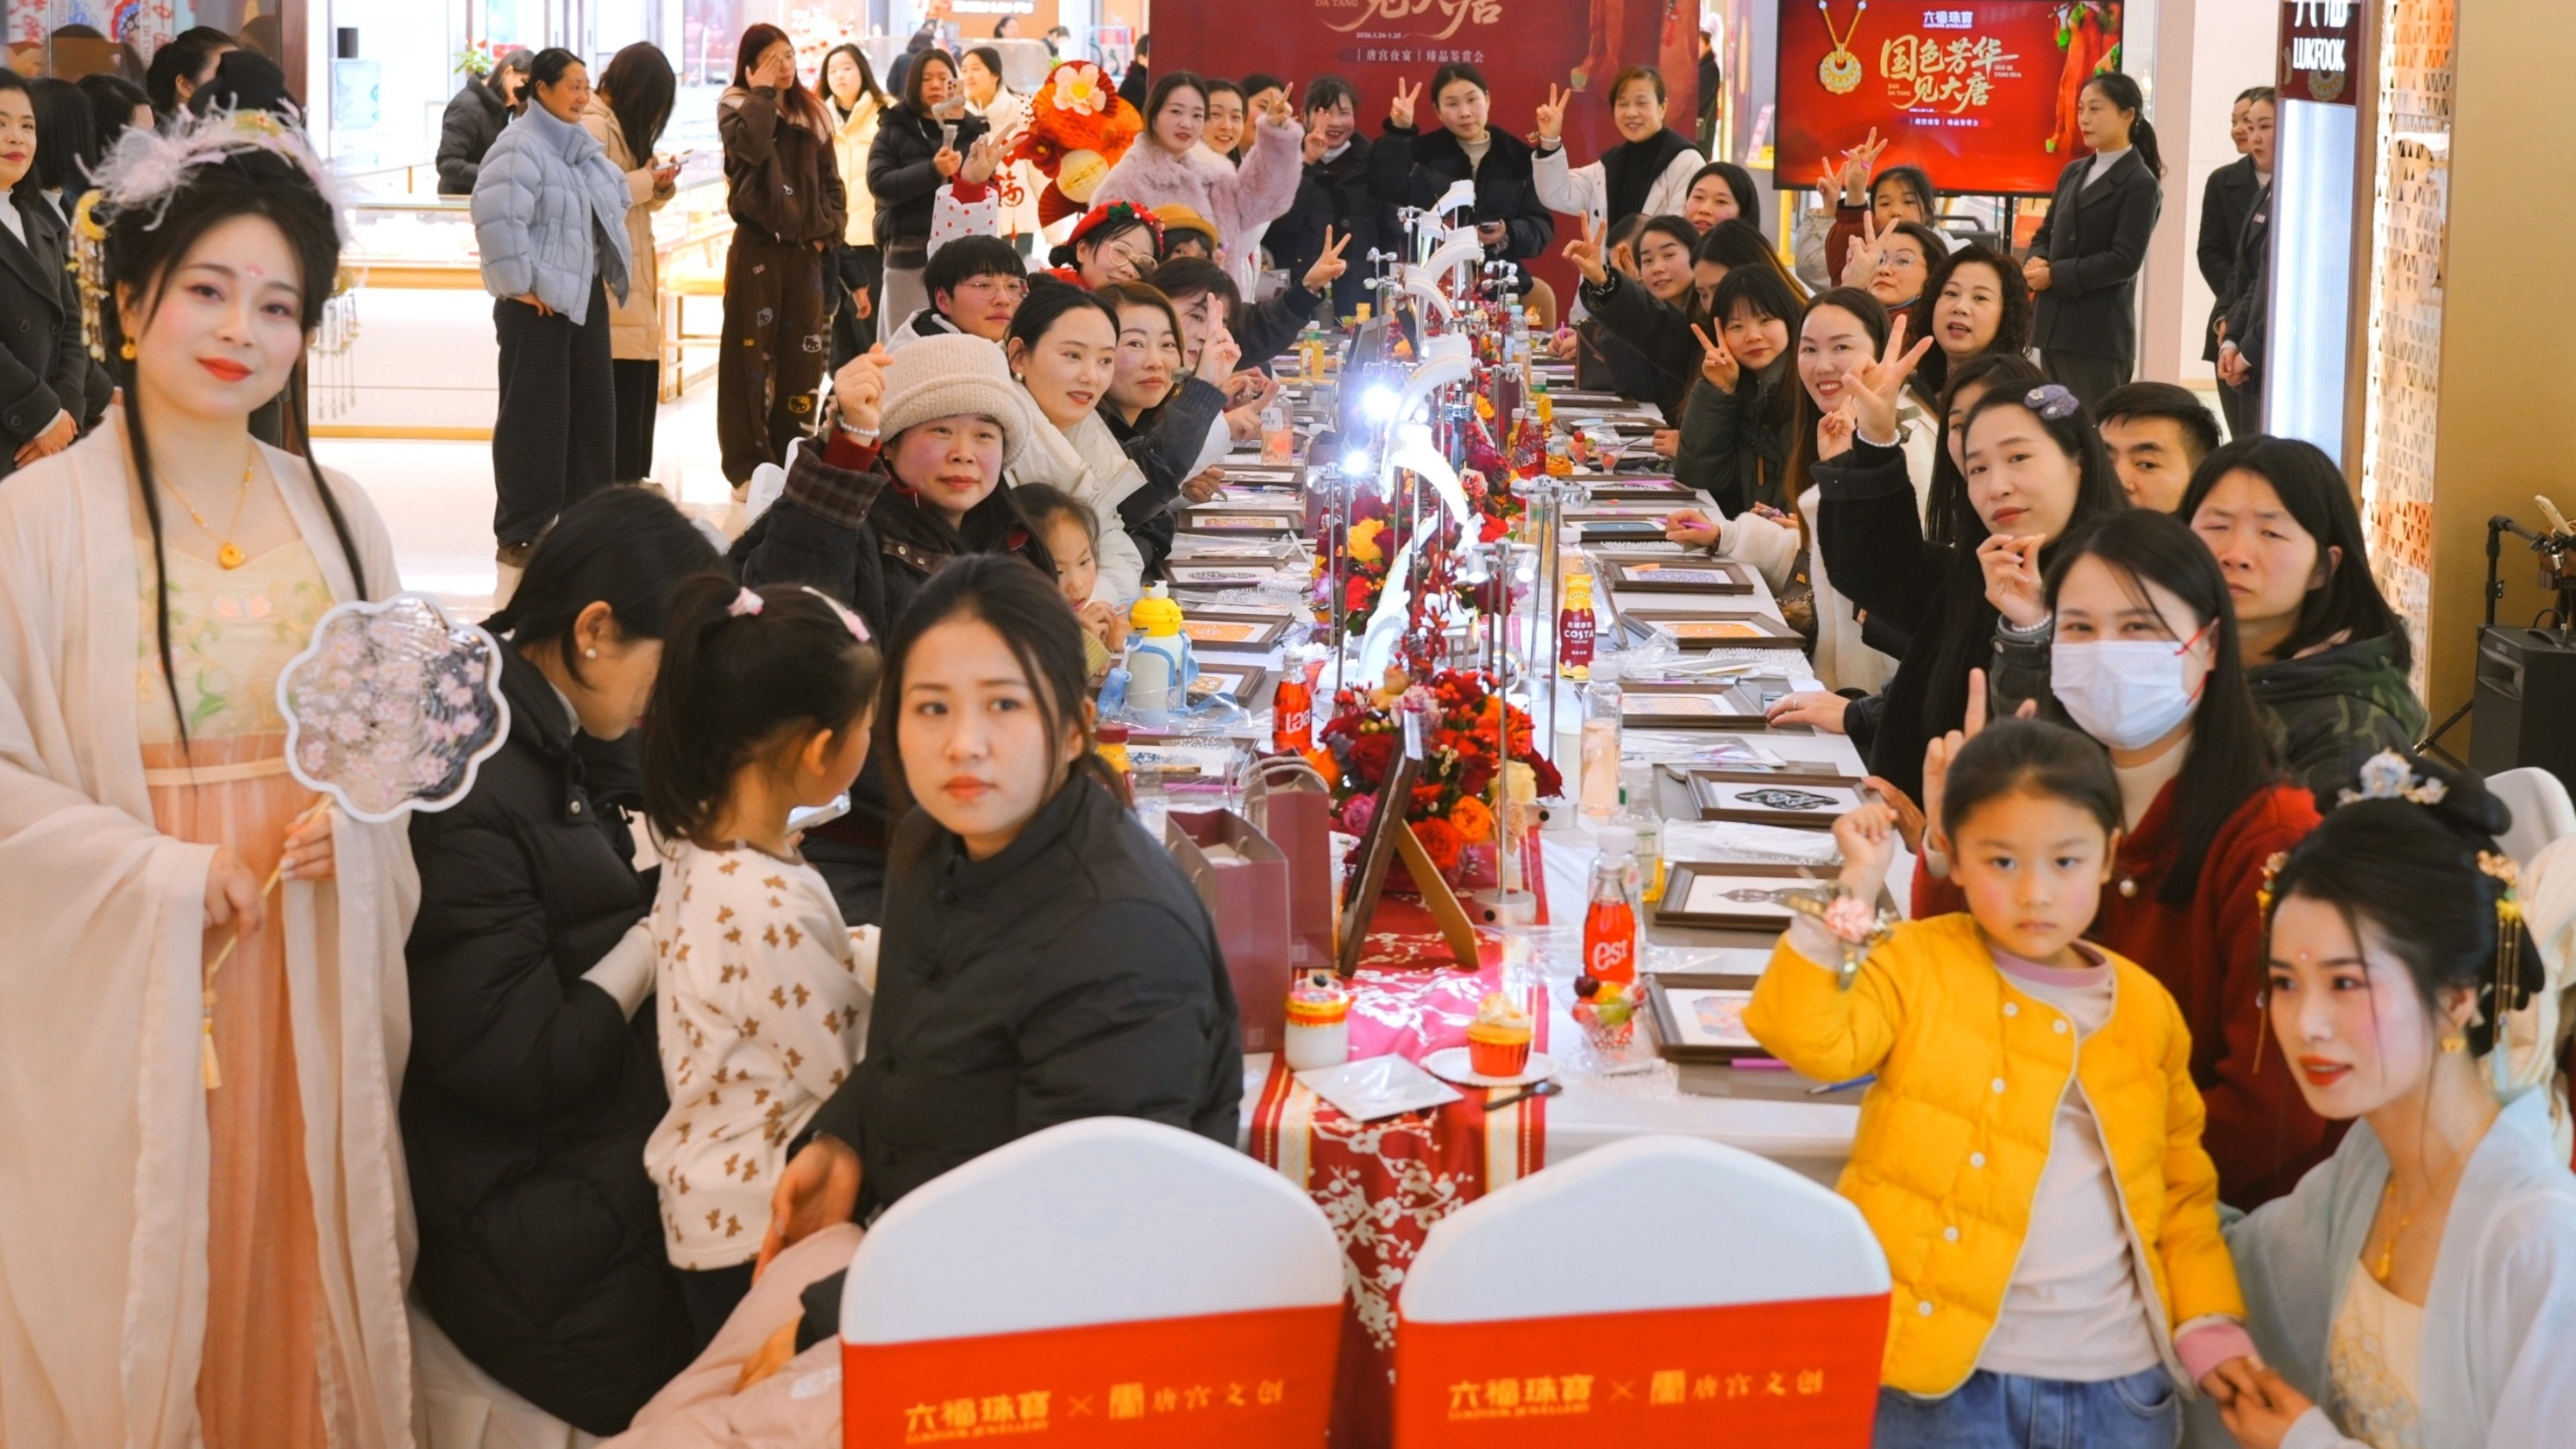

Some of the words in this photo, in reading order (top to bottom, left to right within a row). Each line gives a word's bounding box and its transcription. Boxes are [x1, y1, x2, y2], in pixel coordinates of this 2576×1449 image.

[1366, 48, 1412, 62] 唐宫夜宴
[1880, 34, 2020, 81] 国色芳华
[2292, 37, 2346, 72] LUKFOOK
[1890, 71, 1996, 114] 见大唐
[1564, 630, 1595, 639] COSTA
